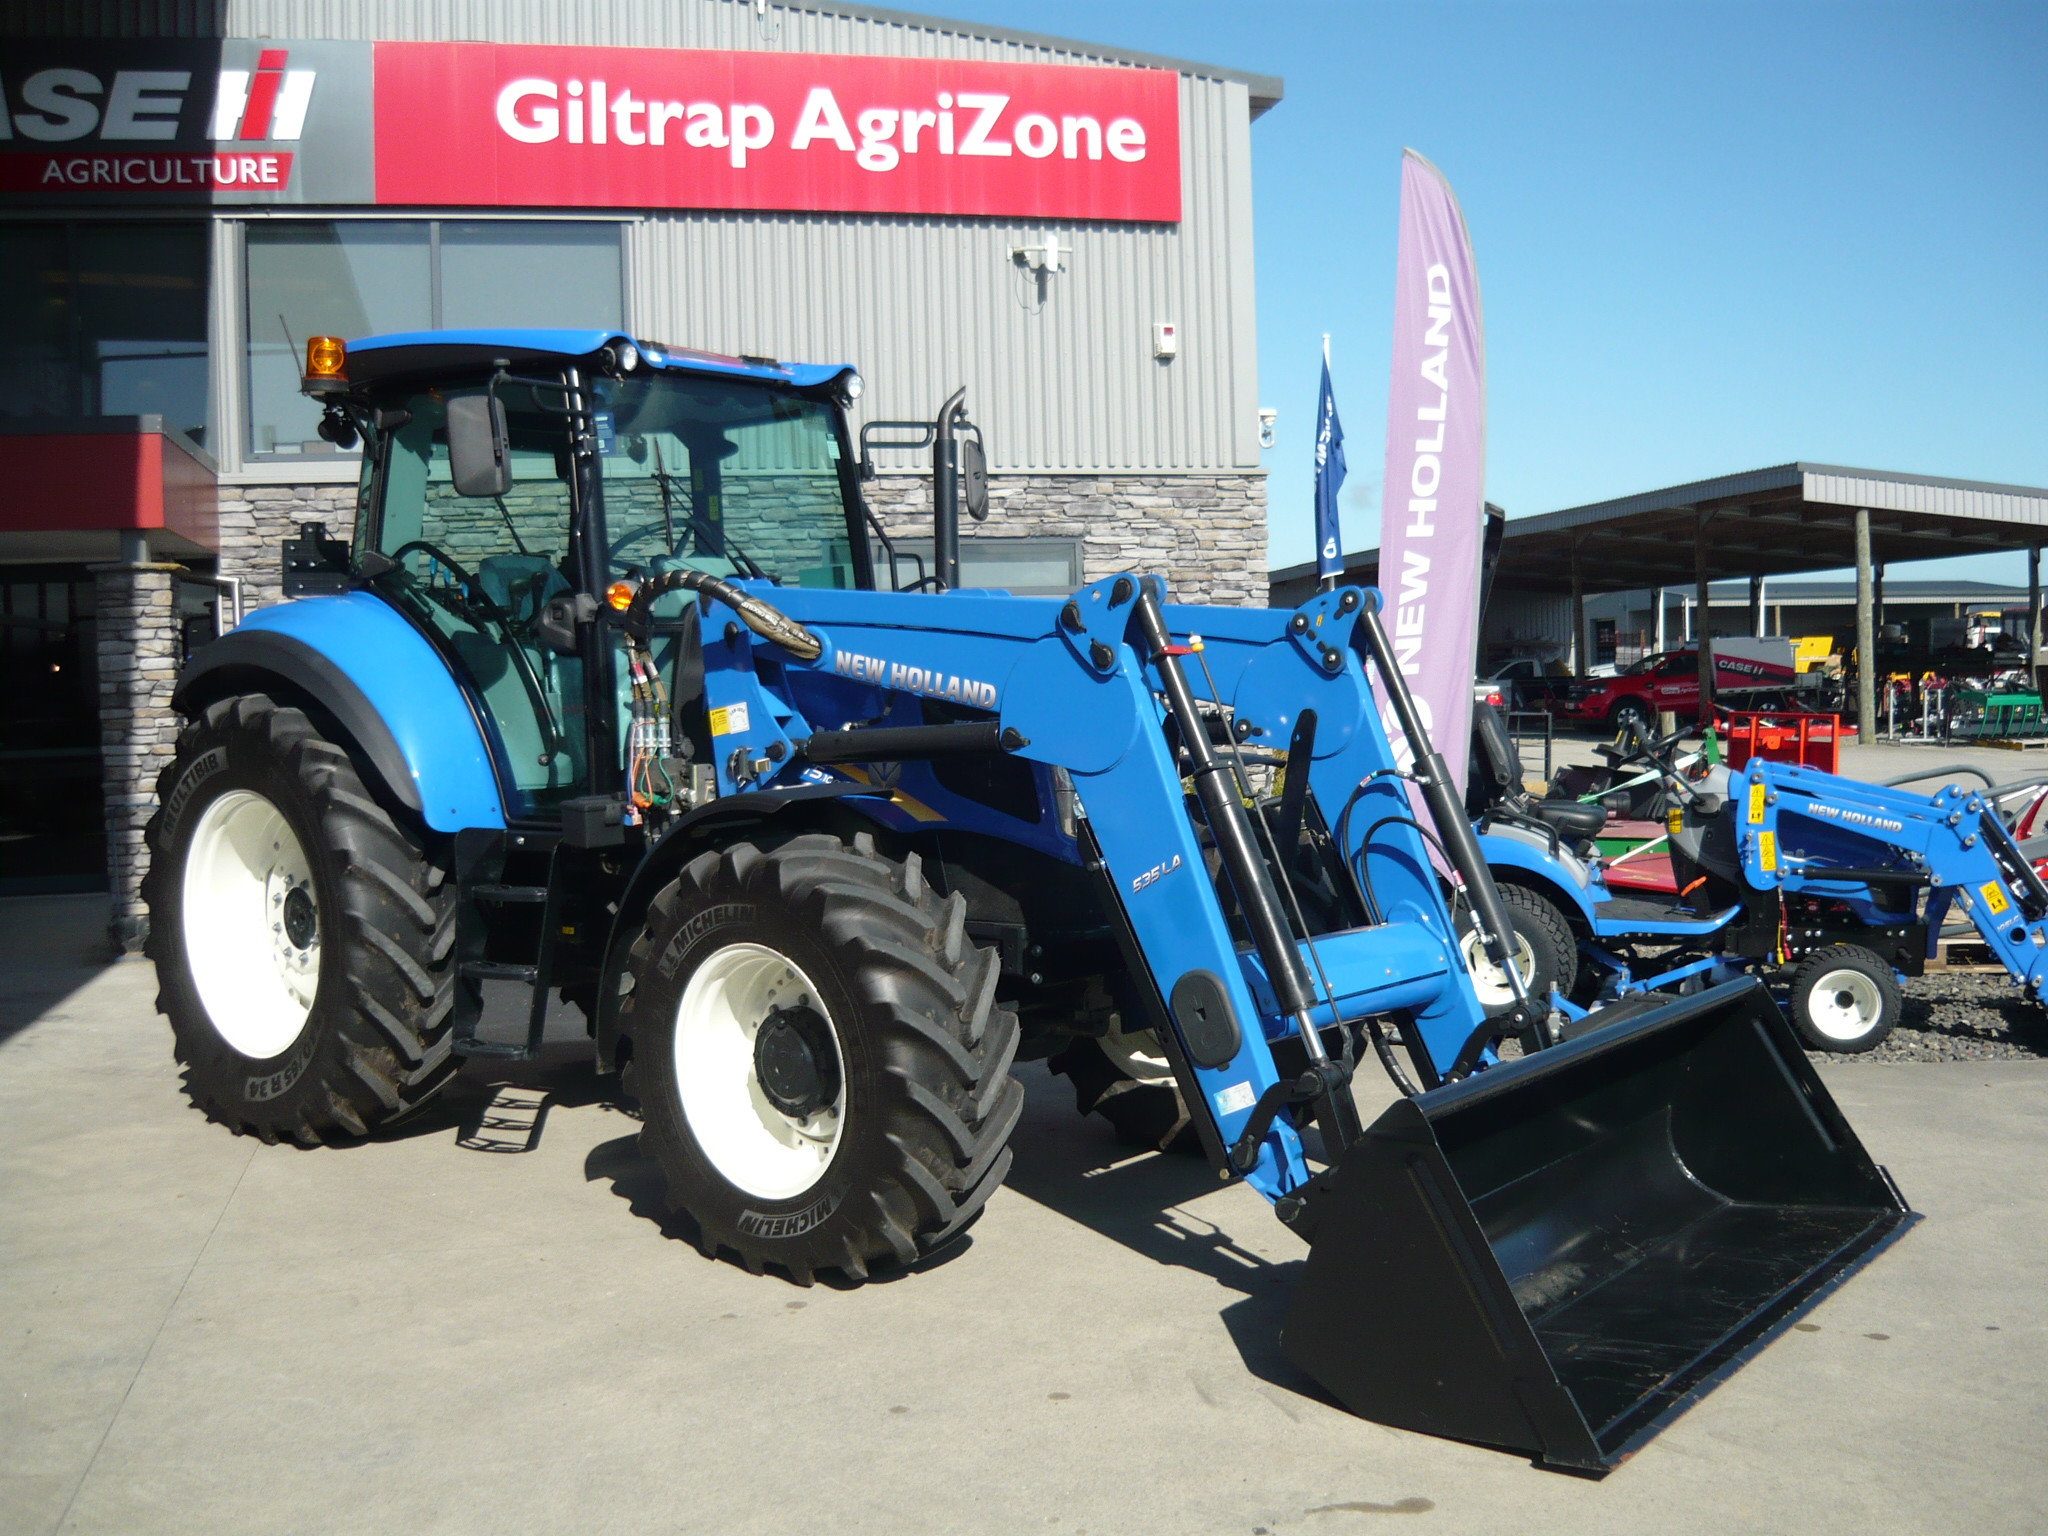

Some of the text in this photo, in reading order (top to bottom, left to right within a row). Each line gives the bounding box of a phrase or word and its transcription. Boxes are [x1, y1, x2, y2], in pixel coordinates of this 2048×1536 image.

[0, 68, 192, 141] SE
[497, 78, 1146, 172] Giltrap AgriZone
[42, 157, 279, 184] AGRICULTURE
[1394, 263, 1452, 676] NEW HOLLAND
[835, 650, 997, 710] NEW HOLLAND
[1718, 660, 1753, 674] CASE
[162, 753, 219, 836] MULTIBIB
[1808, 803, 1903, 832] NEW HOLLAND
[1133, 854, 1182, 894] 535 LA
[673, 905, 754, 955] MICHELIN
[740, 1196, 833, 1235] MICHELIN
